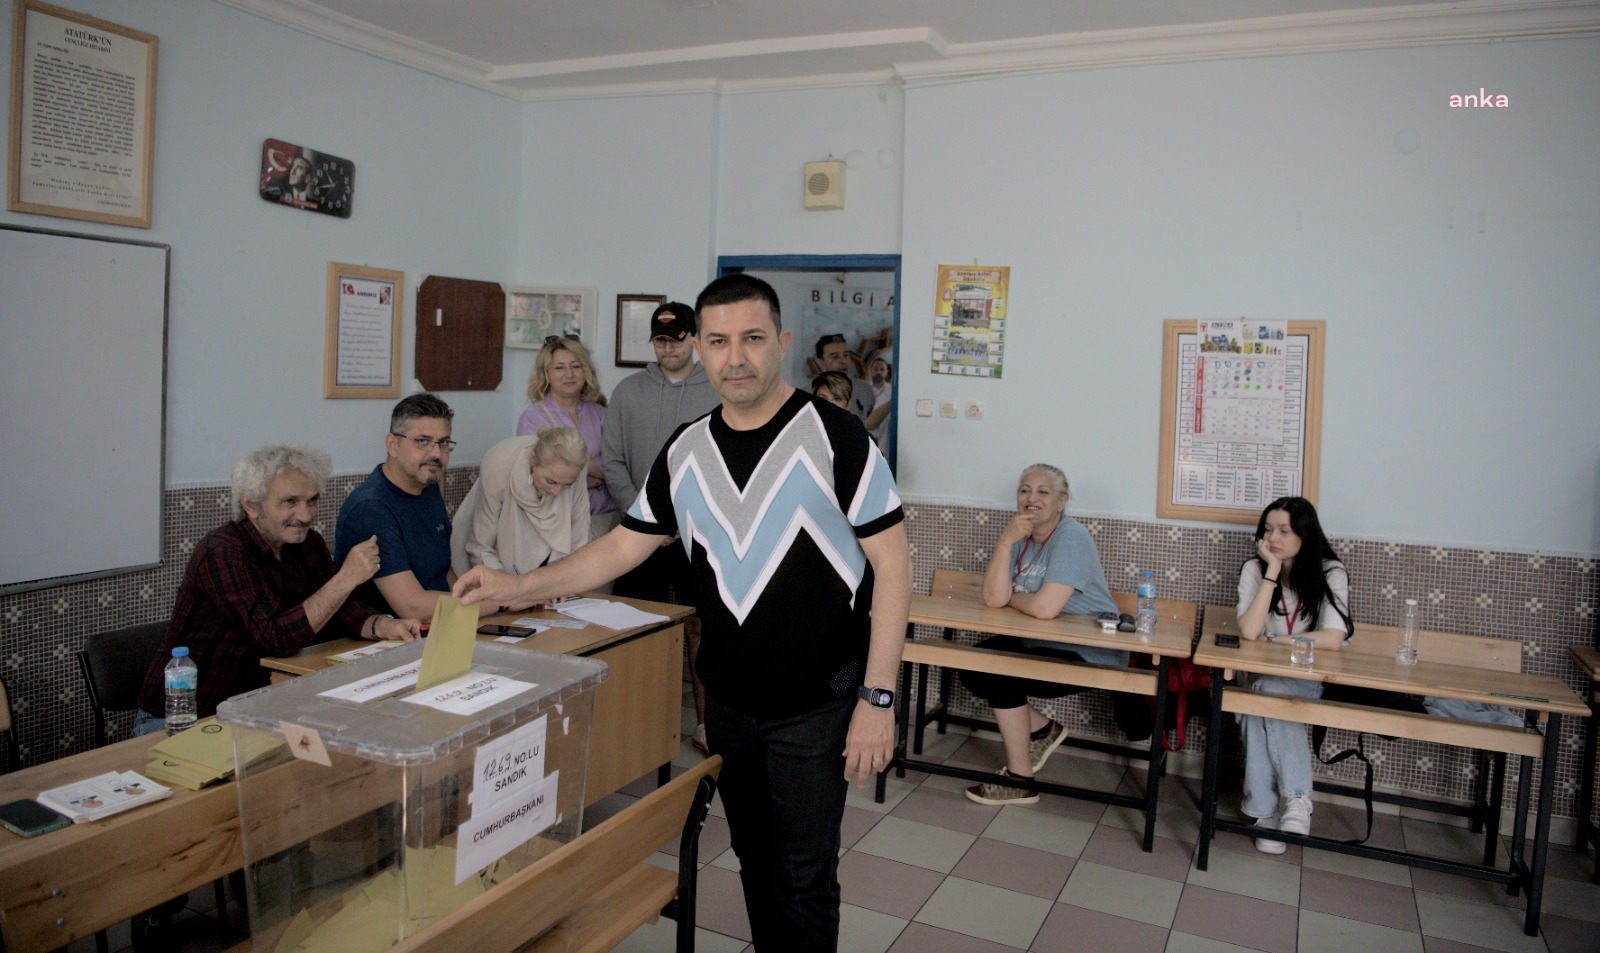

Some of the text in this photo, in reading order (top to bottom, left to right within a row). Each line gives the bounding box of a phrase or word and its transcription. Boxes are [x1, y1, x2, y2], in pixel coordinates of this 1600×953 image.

[483, 745, 540, 782] 1269 NO.LU
[494, 765, 527, 792] SANDIK
[473, 794, 545, 843] CUMHURBAŞKANI
